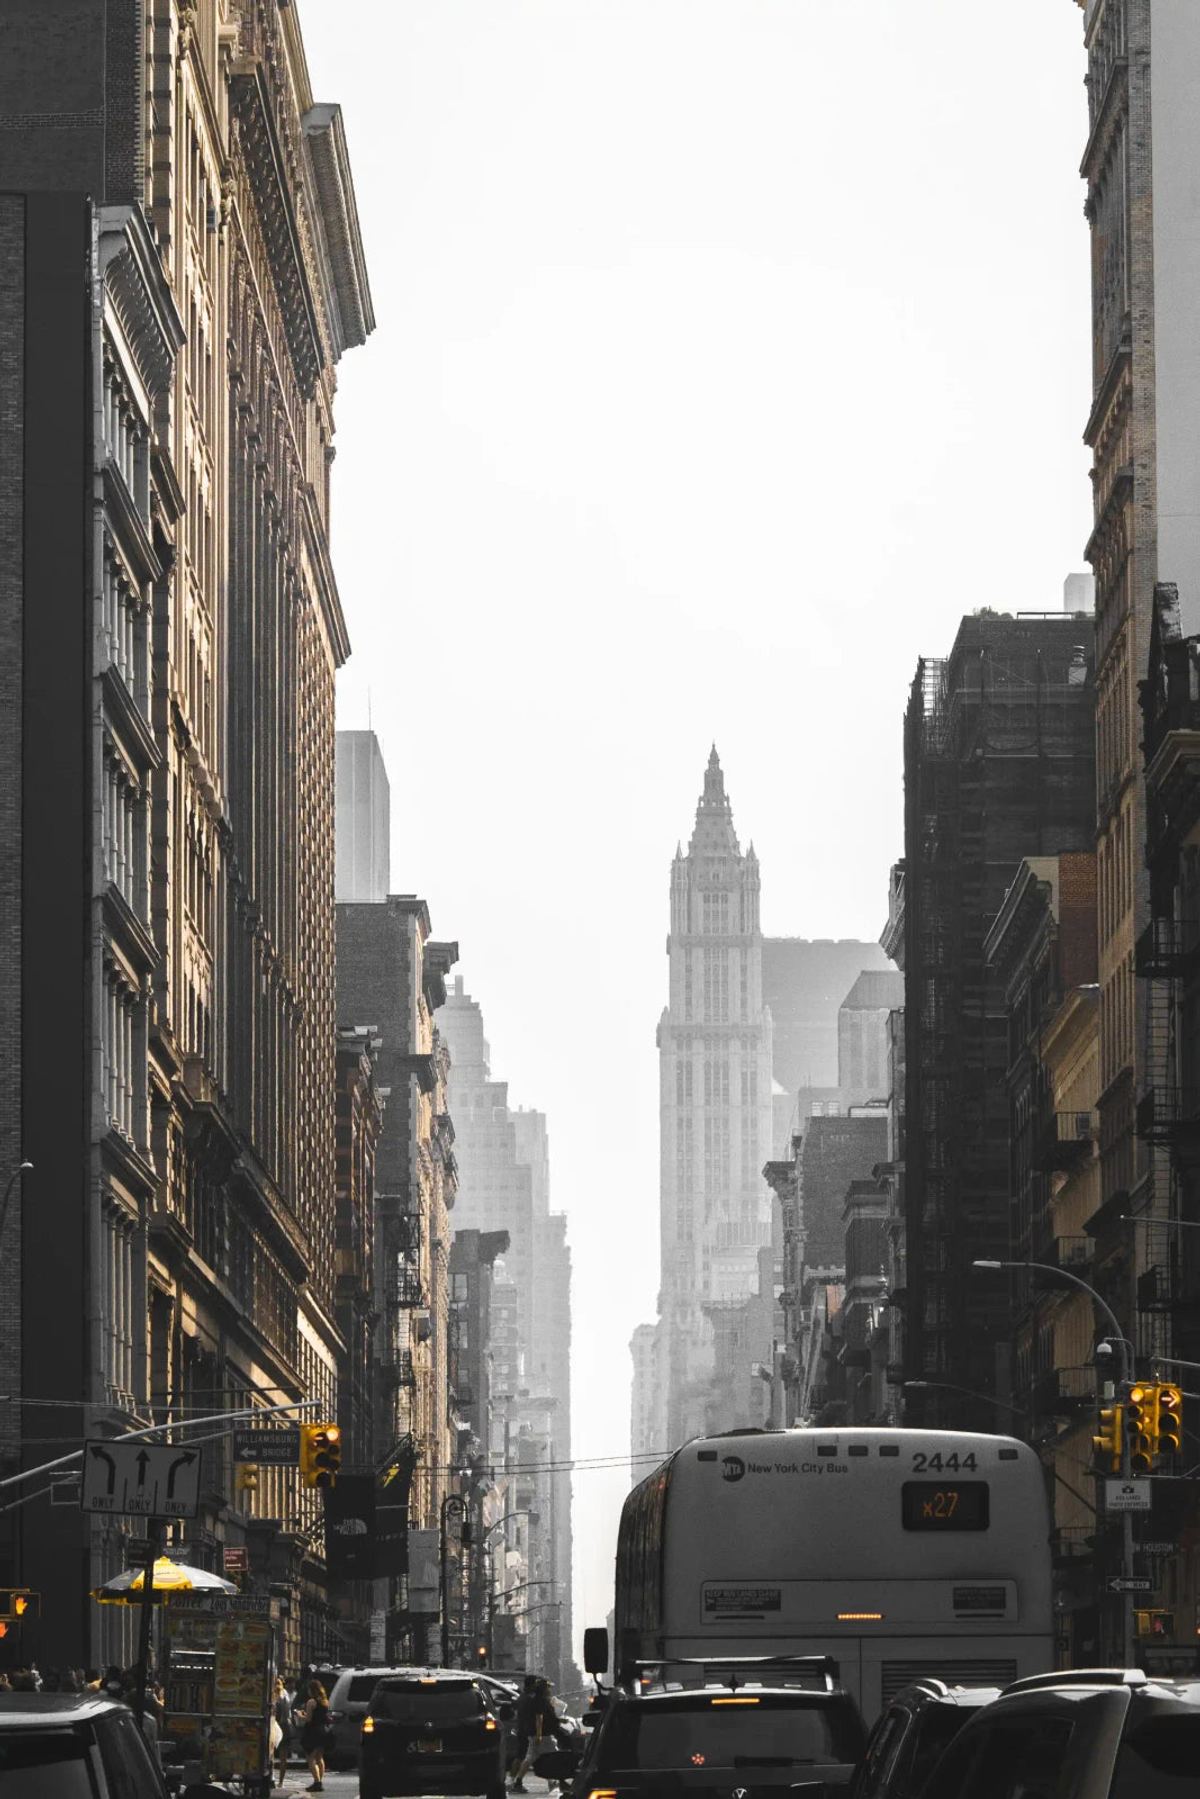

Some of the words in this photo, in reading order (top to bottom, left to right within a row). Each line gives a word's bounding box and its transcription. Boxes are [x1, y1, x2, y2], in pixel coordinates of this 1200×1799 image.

[237, 1434, 297, 1443] WILLIAMSBURG
[262, 1448, 293, 1457] BRIDGE
[748, 1463, 771, 1473] New
[775, 1463, 798, 1473] York
[801, 1463, 823, 1475] City
[827, 1463, 848, 1473] Bus
[912, 1452, 978, 1473] 2444
[92, 1496, 115, 1509] ONLY
[128, 1498, 151, 1511] ONLY
[165, 1501, 187, 1514] ONLY
